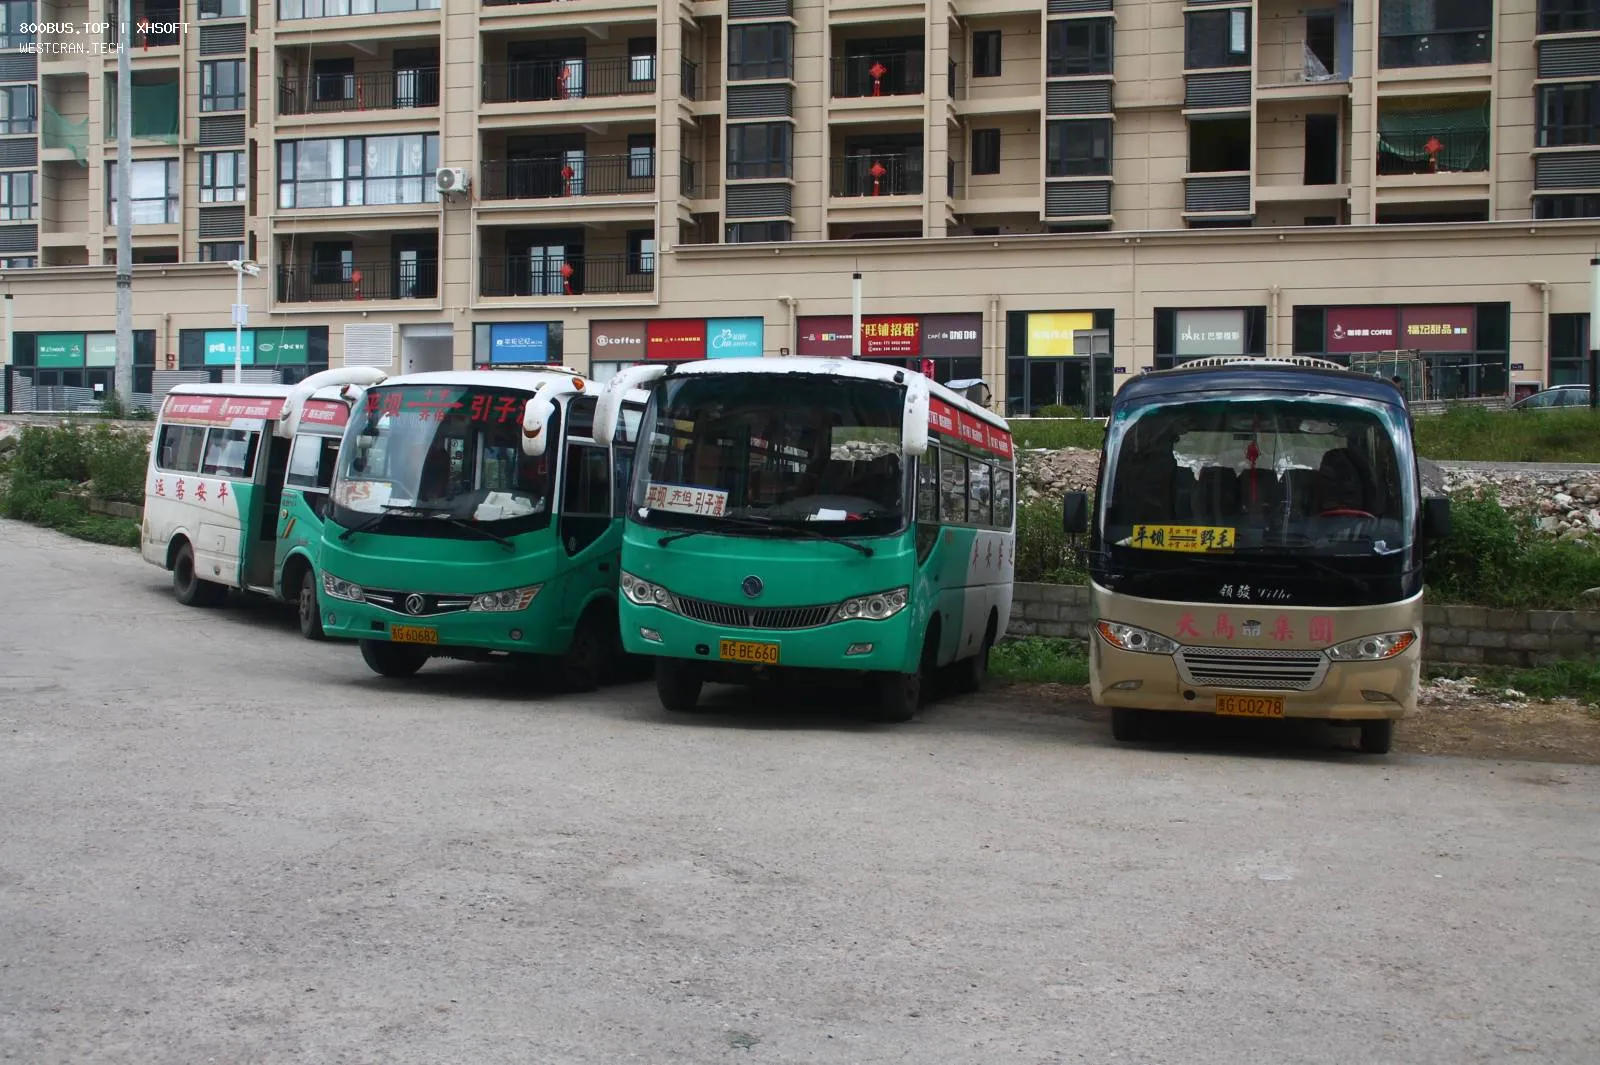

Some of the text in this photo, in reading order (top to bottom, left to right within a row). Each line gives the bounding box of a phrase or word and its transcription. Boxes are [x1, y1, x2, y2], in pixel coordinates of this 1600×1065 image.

[865, 322, 915, 337] 旺铺招租
[1370, 329, 1393, 337] COFFEE
[1407, 324, 1452, 335] 福记甜品
[1134, 526, 1165, 549] 平坝
